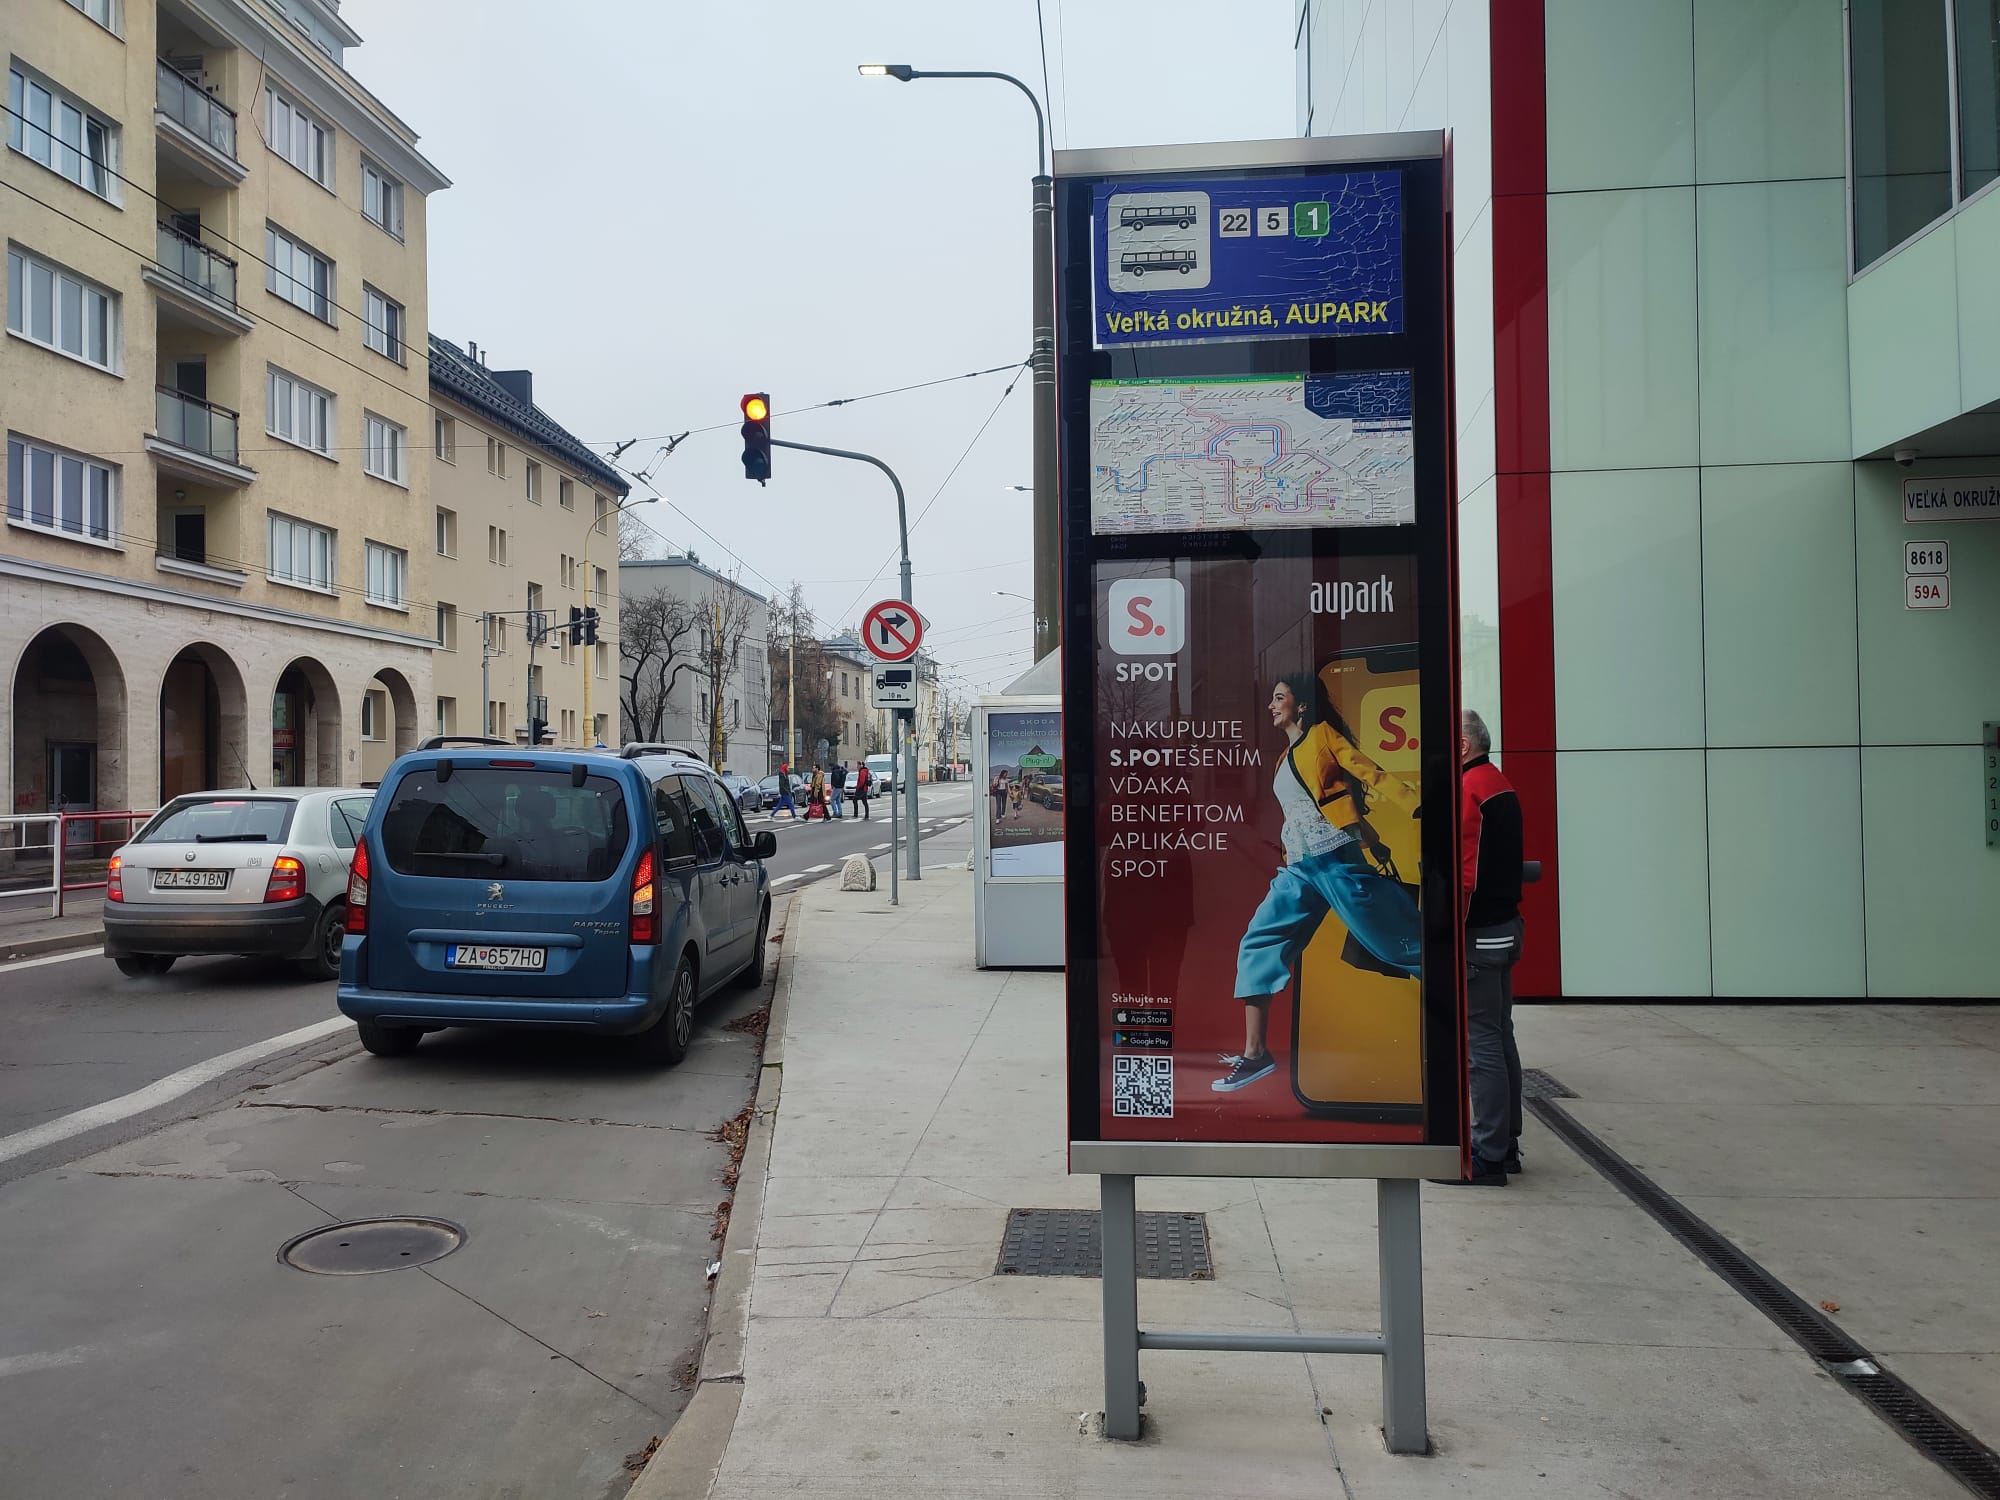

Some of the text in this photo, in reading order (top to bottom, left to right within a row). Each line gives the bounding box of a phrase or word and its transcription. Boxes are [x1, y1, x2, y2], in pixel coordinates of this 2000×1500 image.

[1222, 207, 1319, 232] 22 5 1
[1106, 301, 1389, 334] Veľká okružná, AUPARK
[1907, 488, 1948, 510] VEĽKÁ
[1910, 550, 1943, 565] 8618
[1310, 574, 1394, 620] aupark
[1914, 584, 1941, 600] 59A
[1126, 596, 1166, 637] S.
[1116, 662, 1177, 682] SPOT
[1110, 720, 1243, 740] NAKUPUJTE
[1379, 706, 1420, 752] S.
[1110, 744, 1261, 767] S.POTEŠENÍM
[1989, 755, 1997, 768] 3
[1109, 774, 1190, 795] VĎAKA
[1990, 776, 1998, 789] 2
[1110, 803, 1244, 823] BENEFITOM
[1990, 798, 1998, 810] 1
[1990, 818, 1999, 831] 0
[1109, 829, 1228, 851] APLIKÁCIE
[1110, 859, 1168, 878] SPOT
[163, 872, 225, 886] ZA-491BN
[1157, 996, 1172, 1004] na:
[1131, 1016, 1168, 1025] App Store
[1130, 1037, 1169, 1046] Google Play
